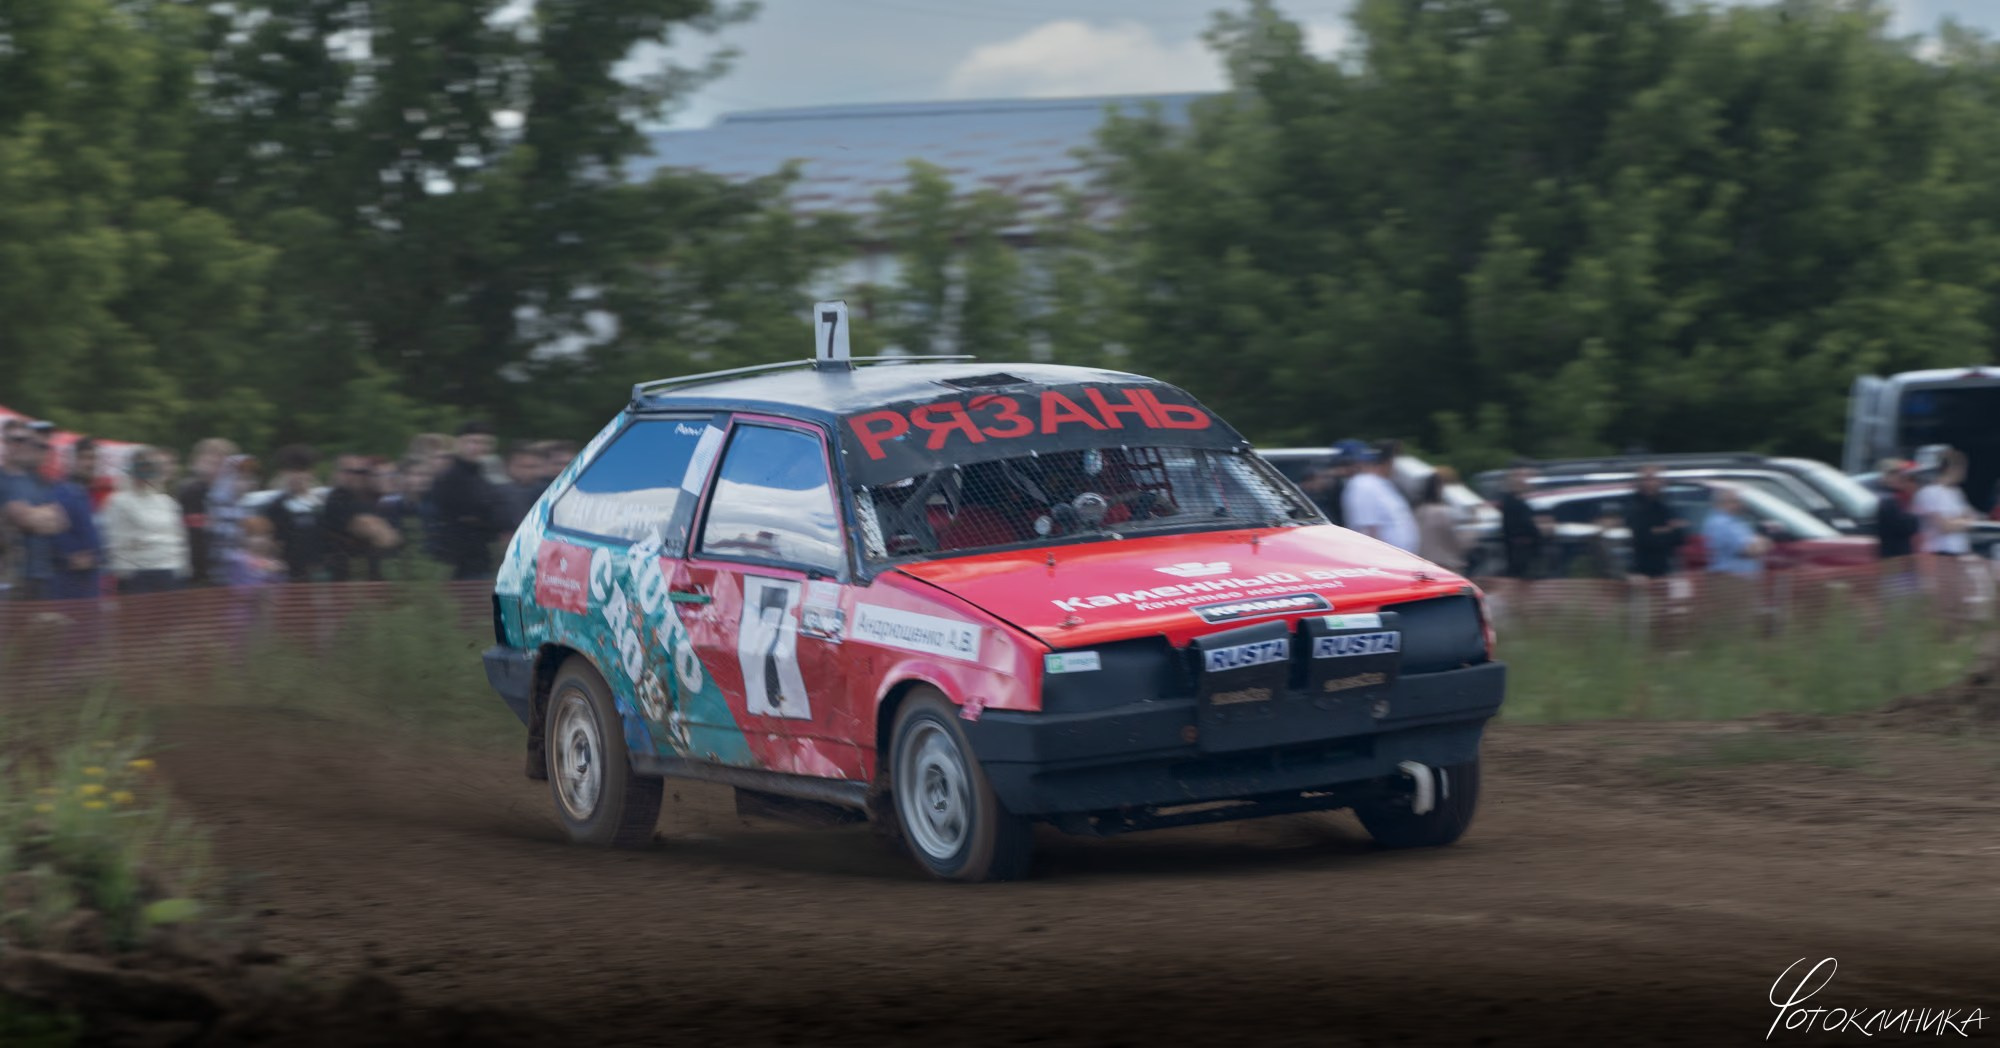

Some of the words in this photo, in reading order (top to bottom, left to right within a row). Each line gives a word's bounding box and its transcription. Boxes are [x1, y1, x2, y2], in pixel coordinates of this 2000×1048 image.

[821, 311, 838, 358] 7
[849, 387, 1211, 460] РЯЗАНЬ
[760, 585, 789, 708] 7
[1212, 639, 1284, 668] RUSTA
[1320, 632, 1395, 655] RUSTA
